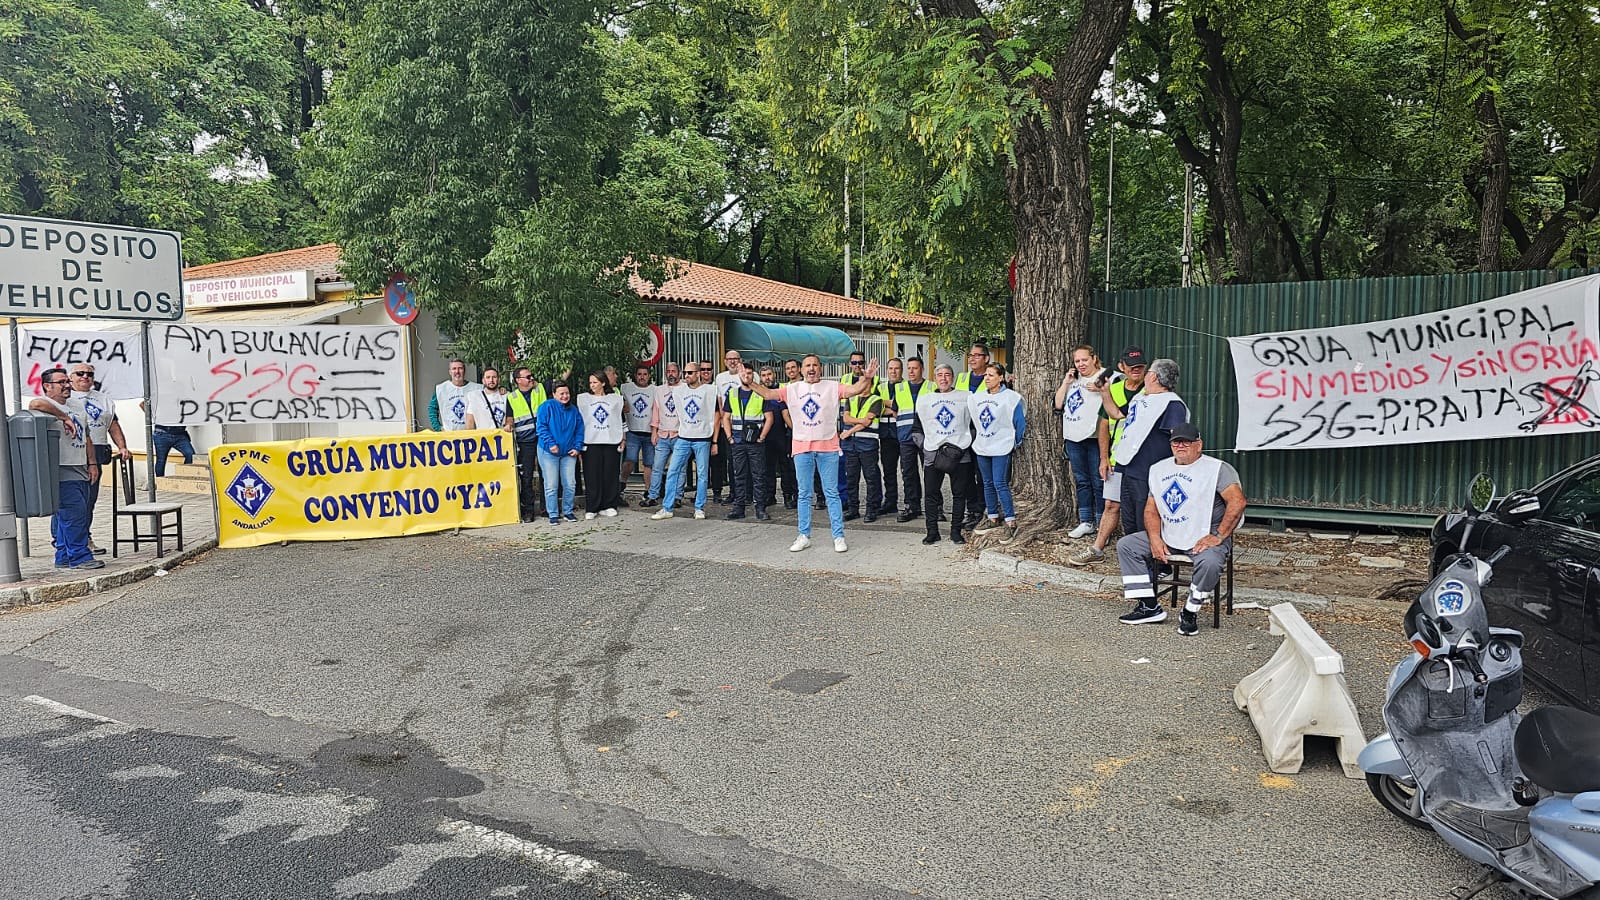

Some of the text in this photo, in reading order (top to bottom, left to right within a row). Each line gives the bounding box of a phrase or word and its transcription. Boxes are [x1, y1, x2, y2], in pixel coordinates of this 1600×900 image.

[0, 224, 157, 259] DEPOSITO
[61, 258, 103, 282] DE
[189, 274, 296, 293] DEPOSITO MUNICIPAL
[206, 289, 278, 303] DE VEHICULOS
[1252, 335, 1352, 367] GRUA
[220, 449, 271, 466] SPPME
[287, 435, 509, 476] GRÚA MUNICIPAL
[303, 486, 440, 524] CONVENIO
